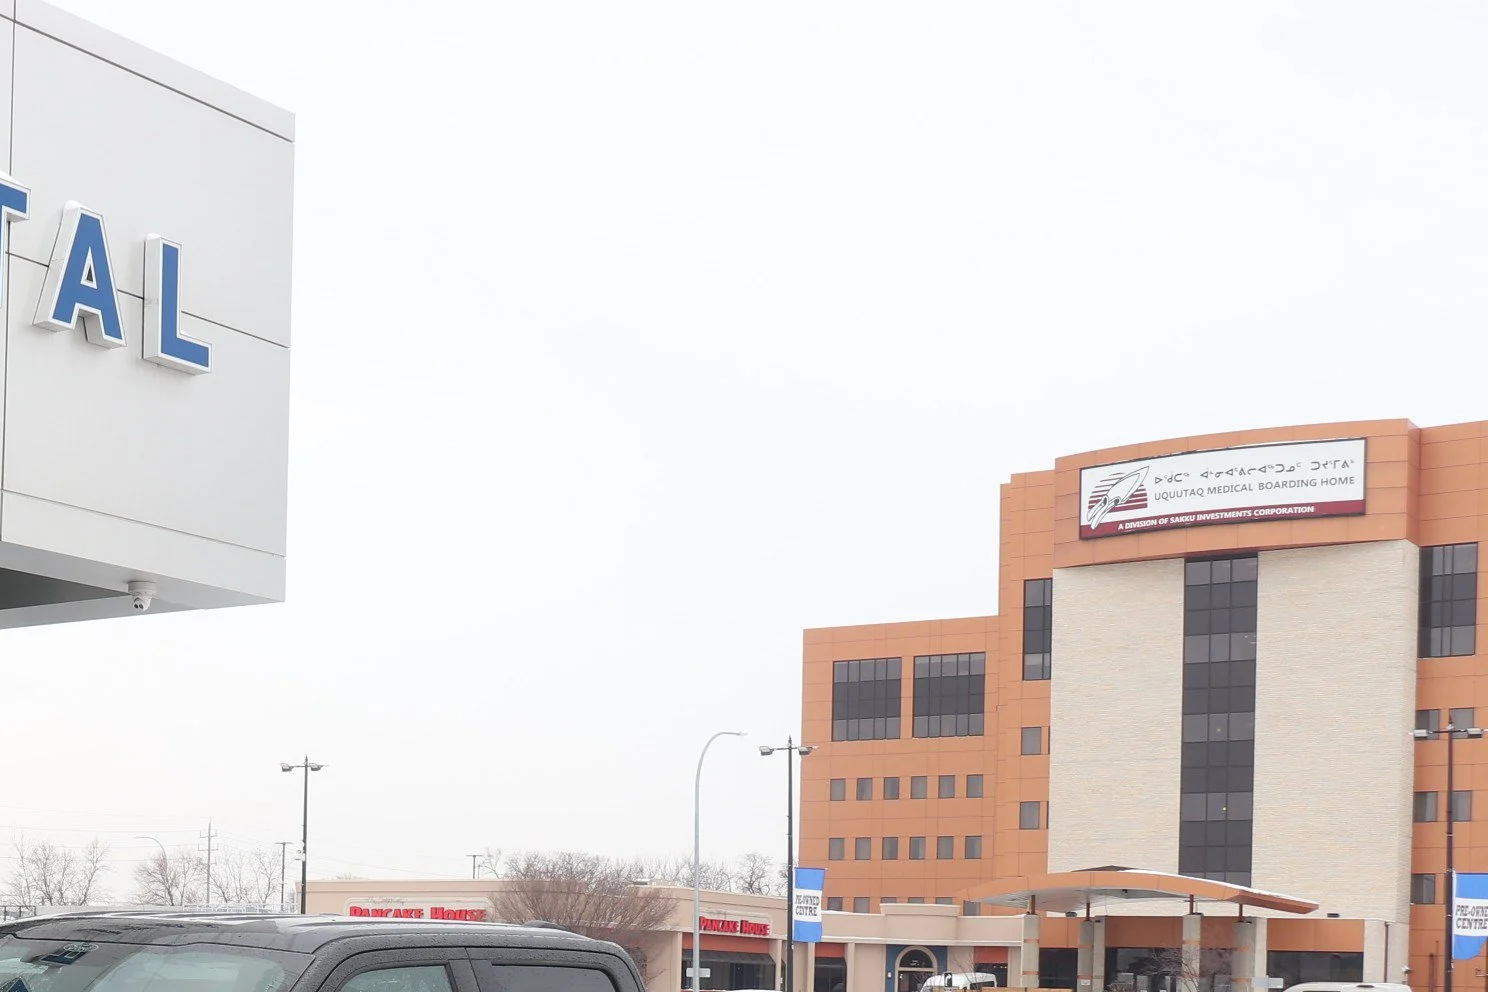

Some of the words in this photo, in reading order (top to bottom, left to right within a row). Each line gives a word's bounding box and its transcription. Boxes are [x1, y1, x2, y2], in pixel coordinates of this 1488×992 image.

[1154, 487, 1204, 501] UQUUTAQ
[1207, 483, 1253, 495] MEDICAL
[1258, 478, 1317, 491] BOARDING
[1320, 476, 1355, 487] HOME
[1124, 519, 1157, 530] DIVISION
[1158, 517, 1169, 525] OF
[1169, 514, 1196, 524] SAKKU
[1196, 509, 1252, 521] INVESTMENTS
[1253, 505, 1315, 517] CORPORATION
[795, 905, 818, 917] CENTRE
[699, 915, 741, 933] PANCAKE
[740, 919, 770, 937] HOUSE
[1455, 917, 1488, 930] CENTRE
